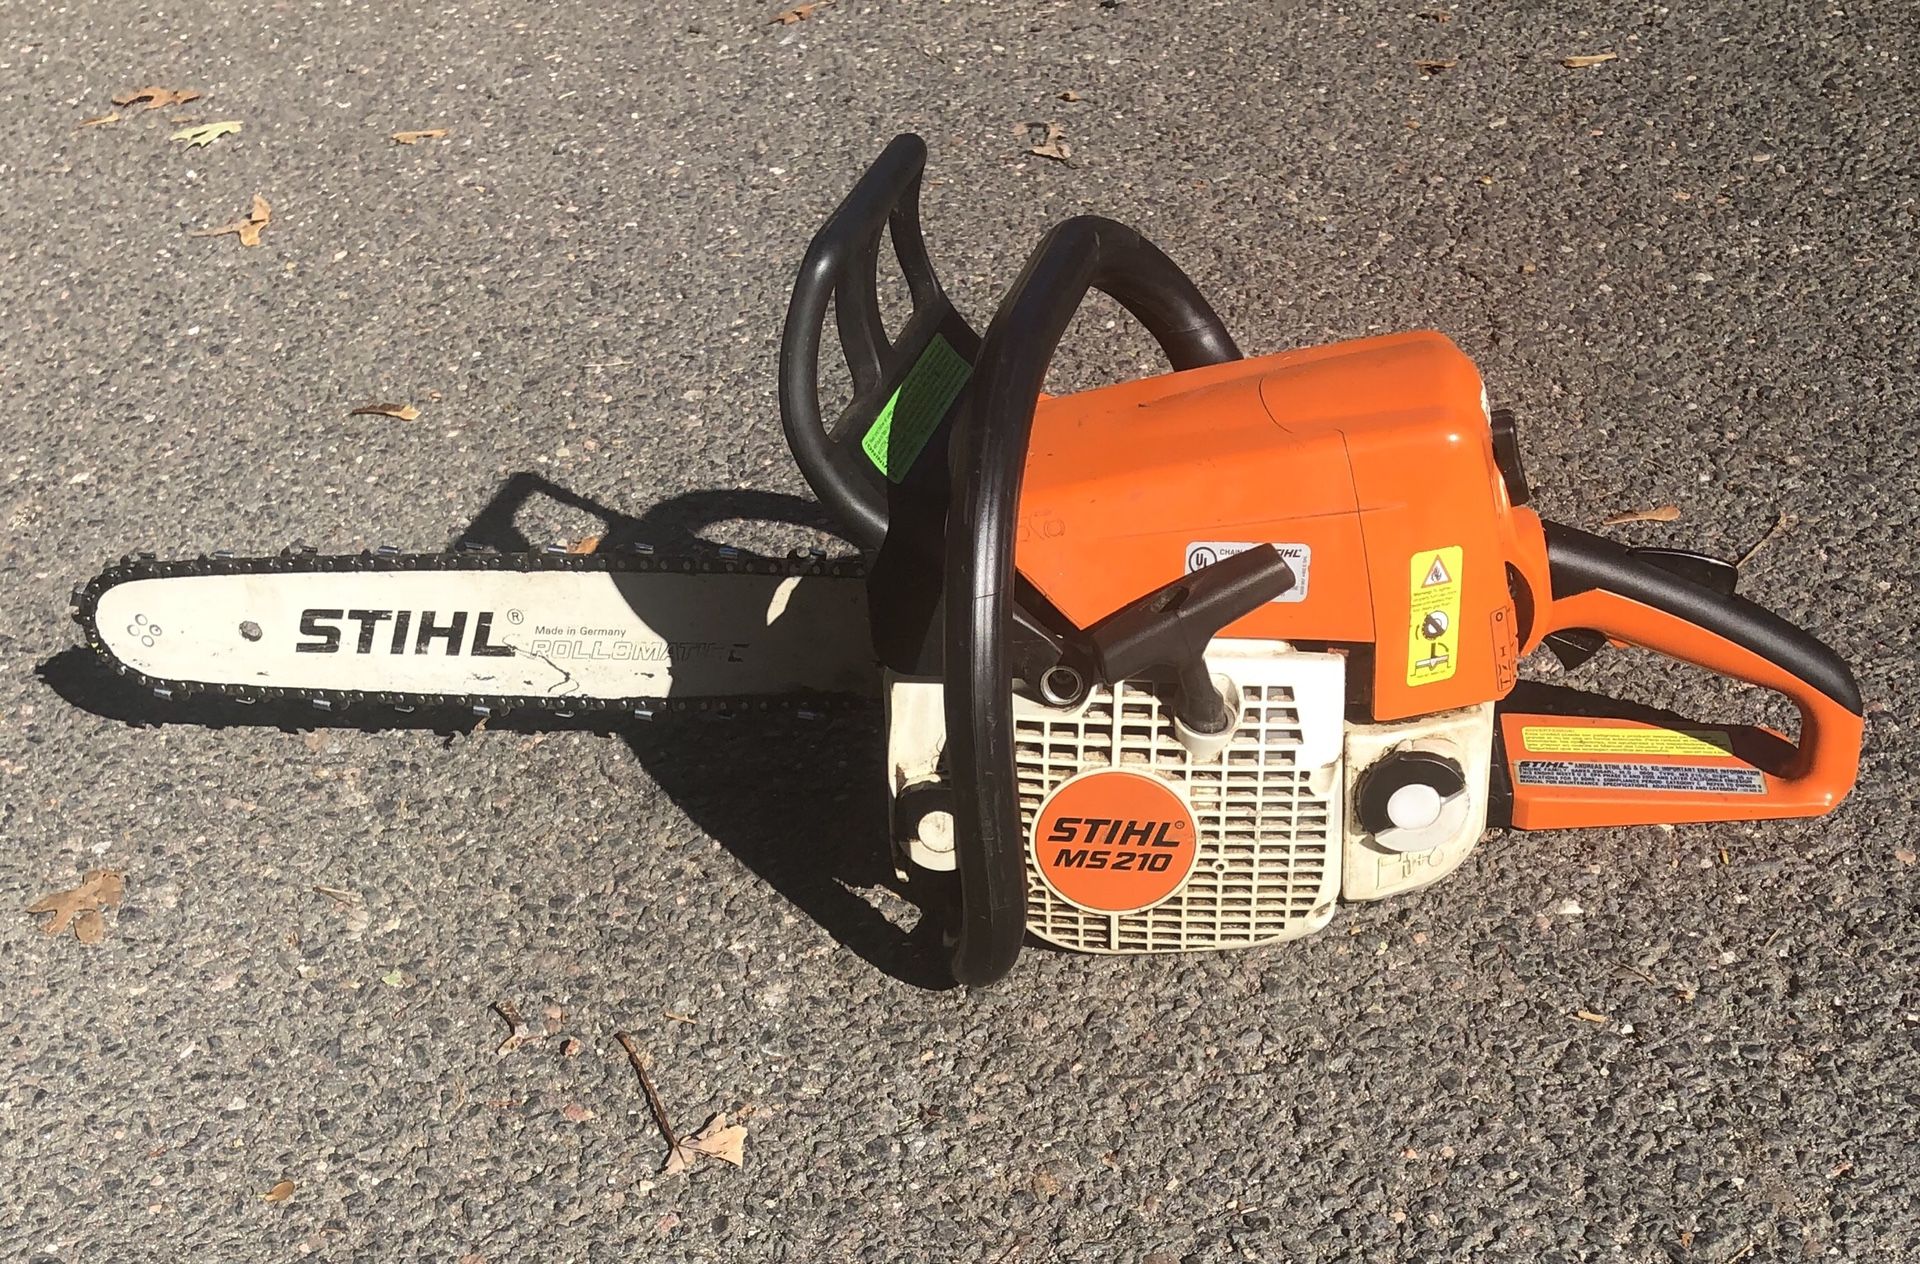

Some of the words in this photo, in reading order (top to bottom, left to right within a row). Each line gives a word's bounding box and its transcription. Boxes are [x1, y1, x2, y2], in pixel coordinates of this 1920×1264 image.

[535, 625, 564, 635] Made
[566, 627, 576, 635] in
[580, 627, 627, 638] Germany
[1053, 849, 1111, 869] MS
[1111, 852, 1172, 872] 210
